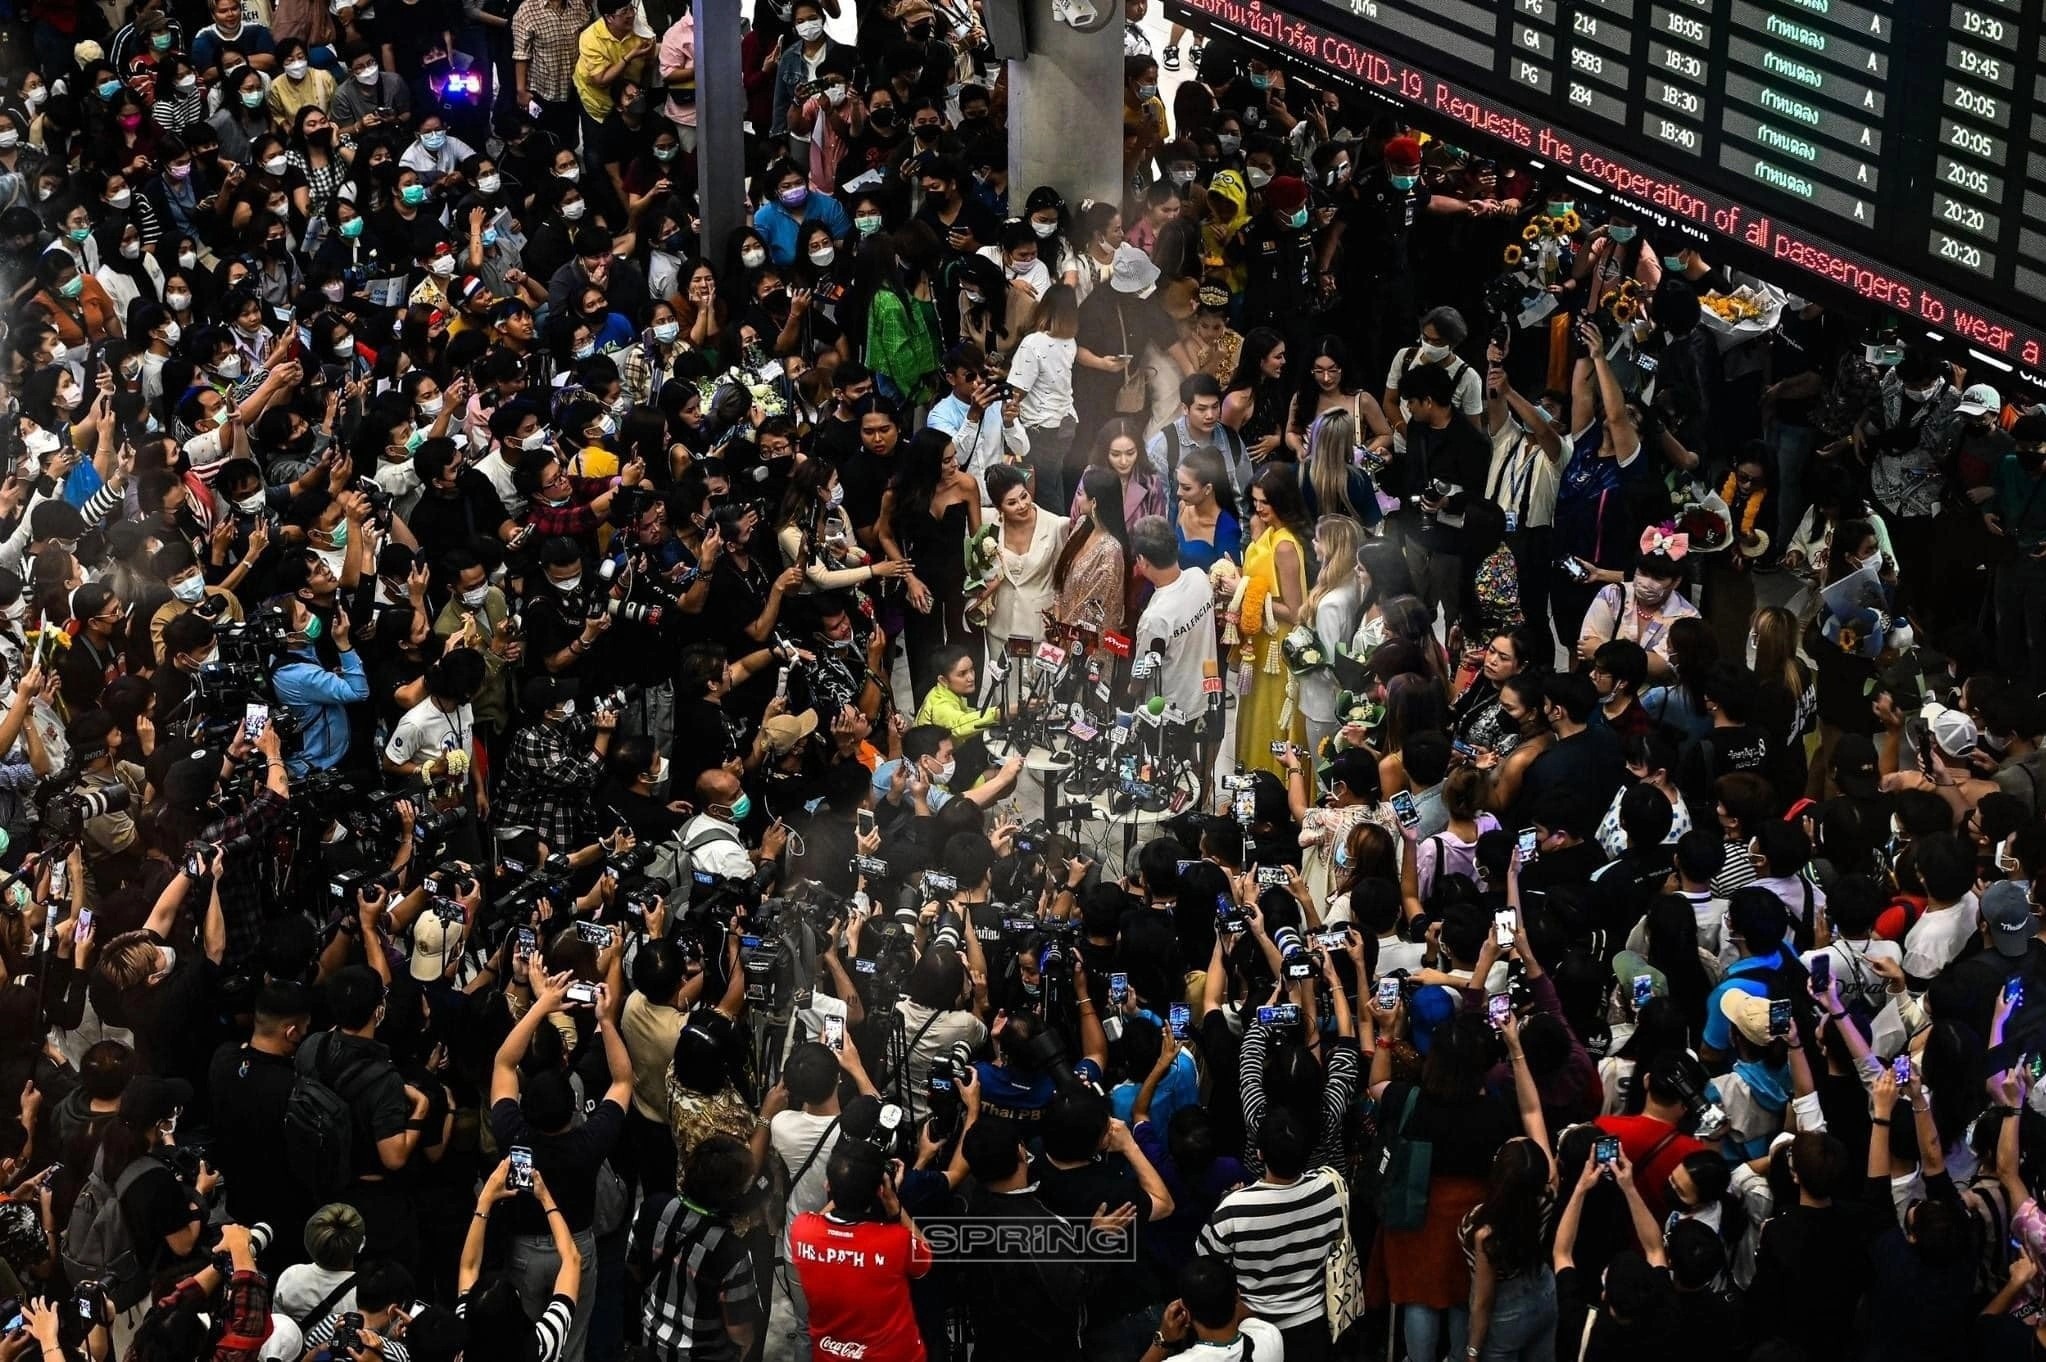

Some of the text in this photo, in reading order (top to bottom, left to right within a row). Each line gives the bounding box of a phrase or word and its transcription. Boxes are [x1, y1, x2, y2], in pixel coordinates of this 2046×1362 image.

[1574, 12, 1596, 36] 214
[1668, 13, 1703, 41] 18:05
[1870, 14, 1881, 34] A
[1963, 11, 2003, 41] 19:30
[1523, 29, 1540, 49] GA
[1520, 63, 1538, 84] PG
[1571, 47, 1602, 74] 9583
[1665, 49, 1700, 77] 18:30
[1867, 51, 1877, 71] A
[1960, 50, 2000, 80] 19:45
[1569, 83, 1592, 106] 284
[1662, 85, 1697, 112] 18:30
[1863, 89, 1874, 109] A
[1955, 87, 1996, 118] 20:05
[1660, 120, 1694, 148] 18:40
[1860, 127, 1871, 146] A
[1951, 125, 1992, 156] 20:05
[1857, 163, 1867, 182] A
[1948, 162, 1989, 193] 20:05
[1436, 82, 1531, 147] Requests
[1539, 128, 1572, 164] the
[1580, 152, 1707, 222] cooperation
[1714, 206, 1740, 234] of
[1745, 217, 1769, 248] all
[1775, 233, 1911, 309] passengers
[1921, 291, 1944, 322] to
[1954, 309, 2014, 351] wear
[2022, 341, 2039, 364] a
[1853, 201, 1864, 220] A
[1944, 200, 1984, 230] 20:20
[1940, 237, 1980, 267] 20:20
[819, 1336, 868, 1360] Coca-Cola
